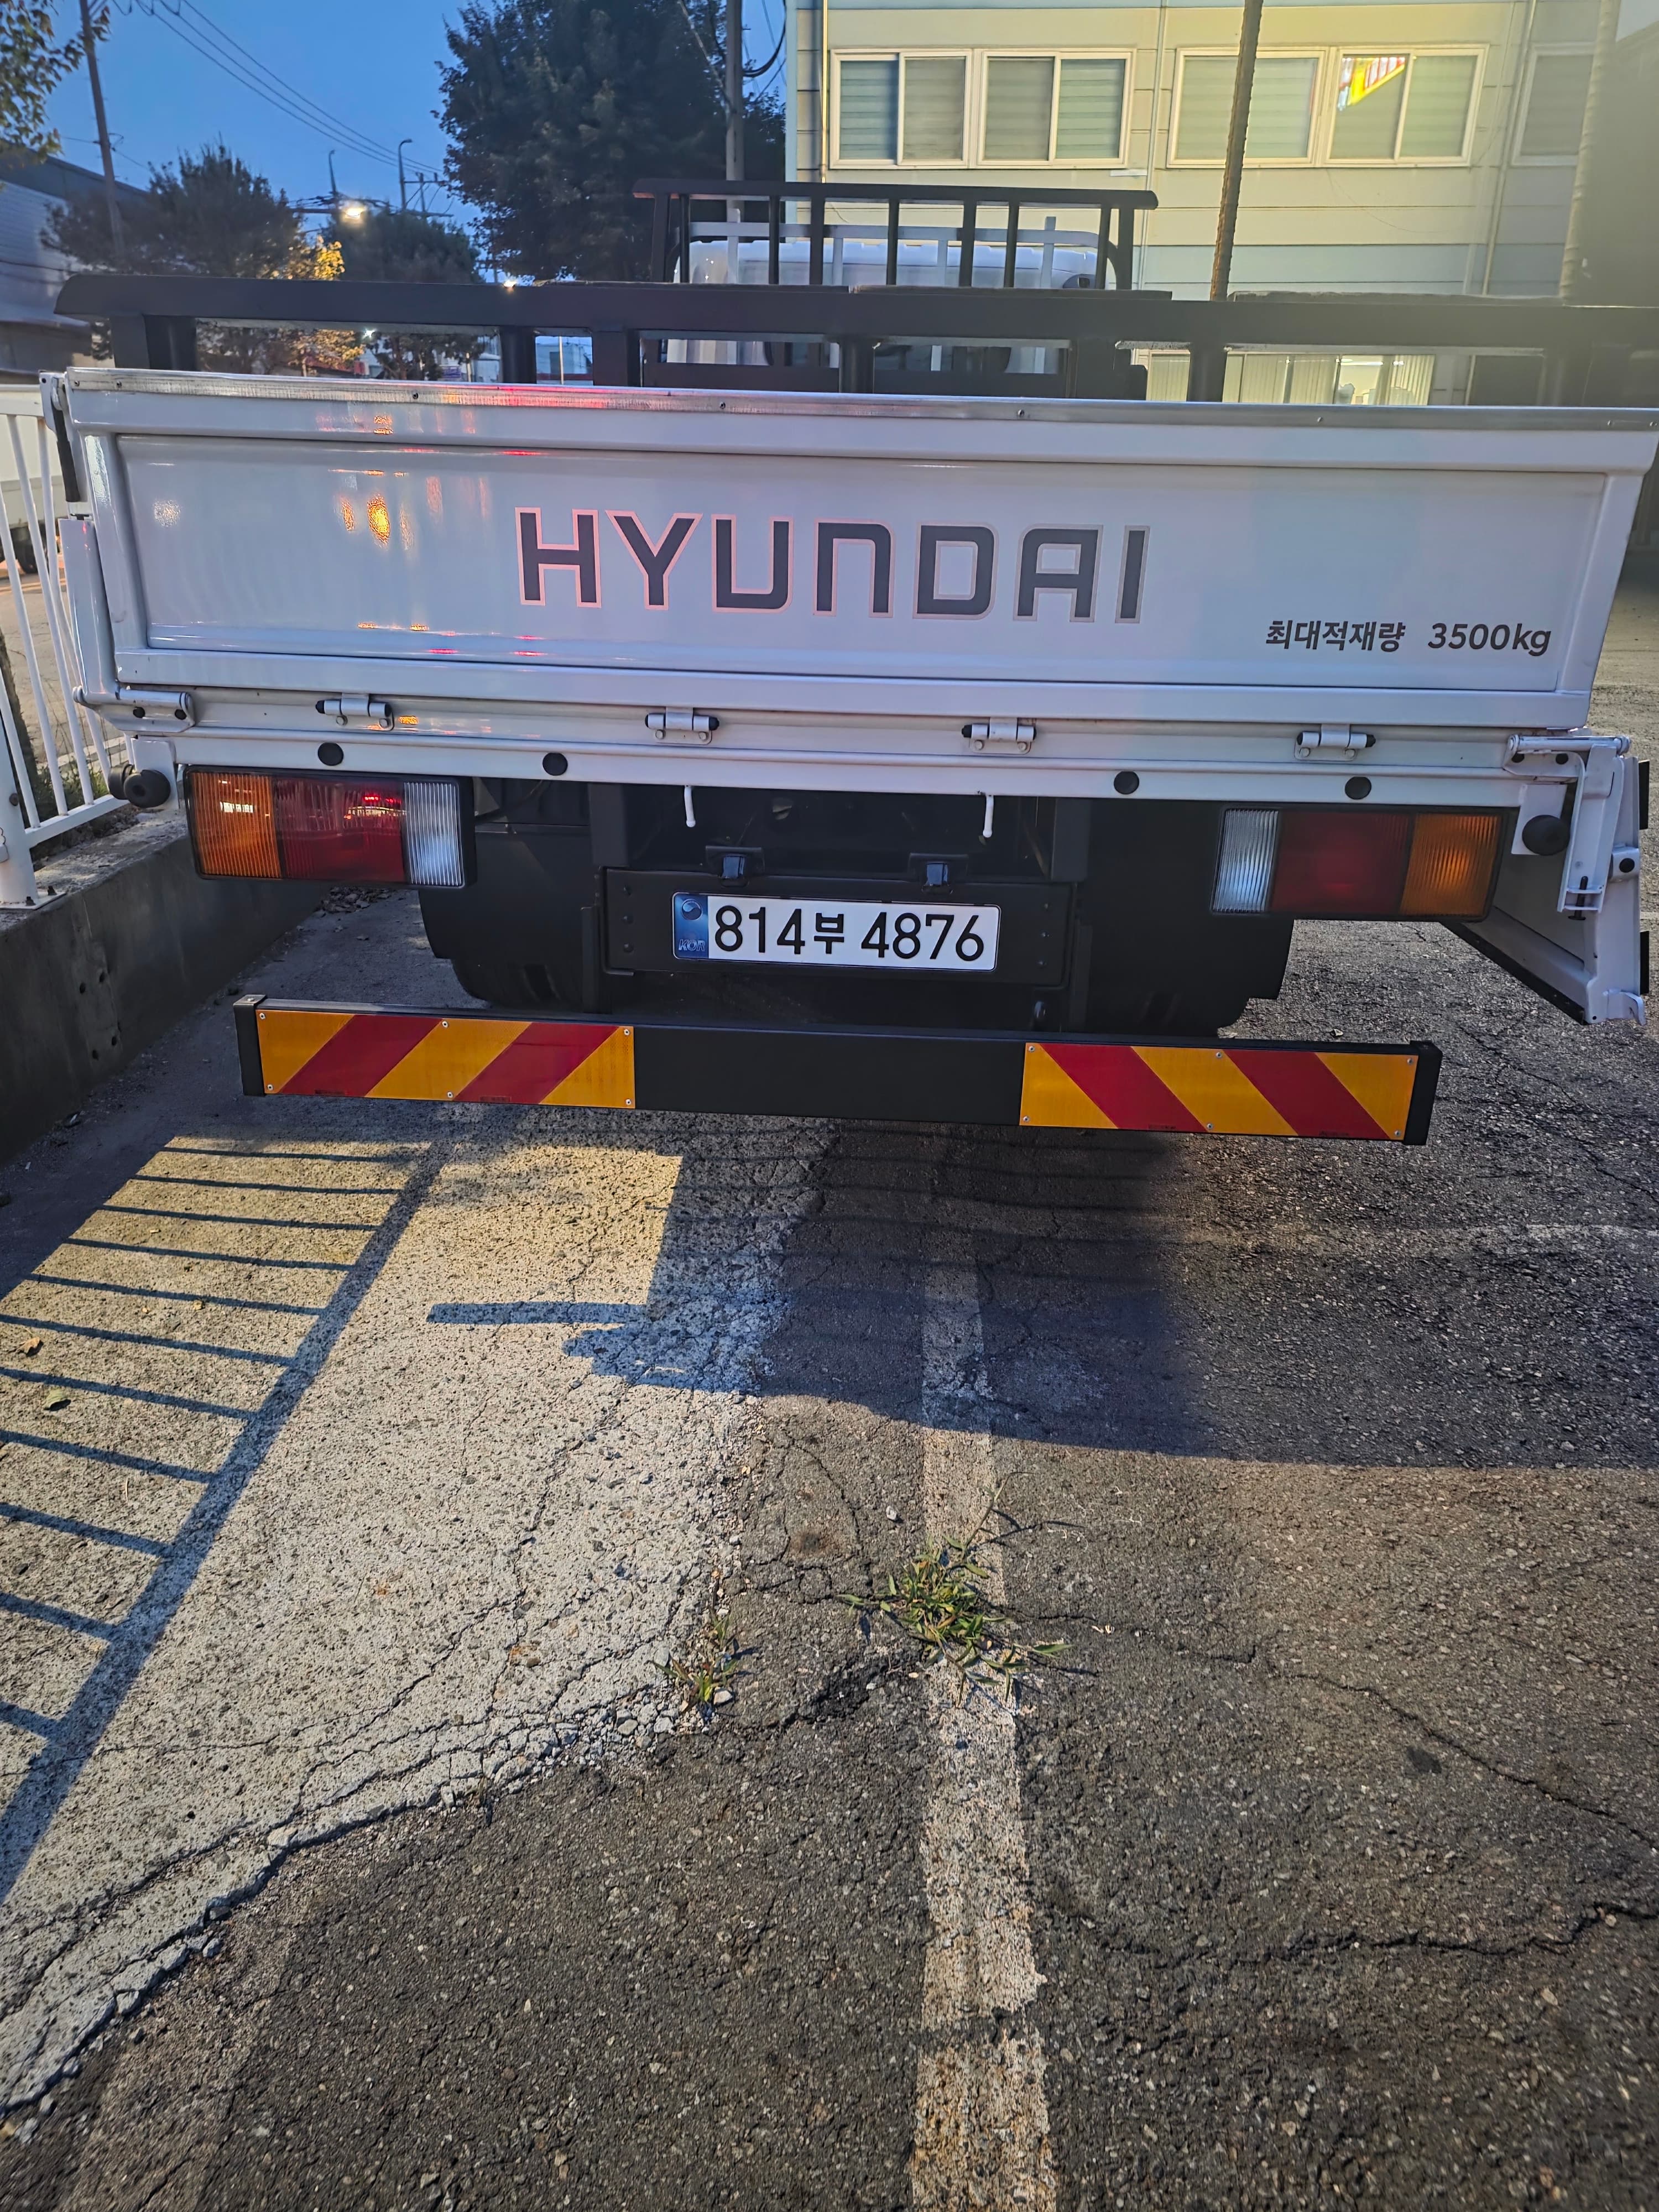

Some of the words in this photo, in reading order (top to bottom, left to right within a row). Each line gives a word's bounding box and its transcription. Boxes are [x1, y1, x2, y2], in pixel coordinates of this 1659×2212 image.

[515, 507, 1151, 624] HYUNDAI
[1266, 620, 1406, 652] 최대적재량
[1428, 623, 1552, 656] 3500kg
[679, 939, 706, 952] KOR
[714, 905, 844, 955] 814부
[860, 912, 984, 962] 4876
